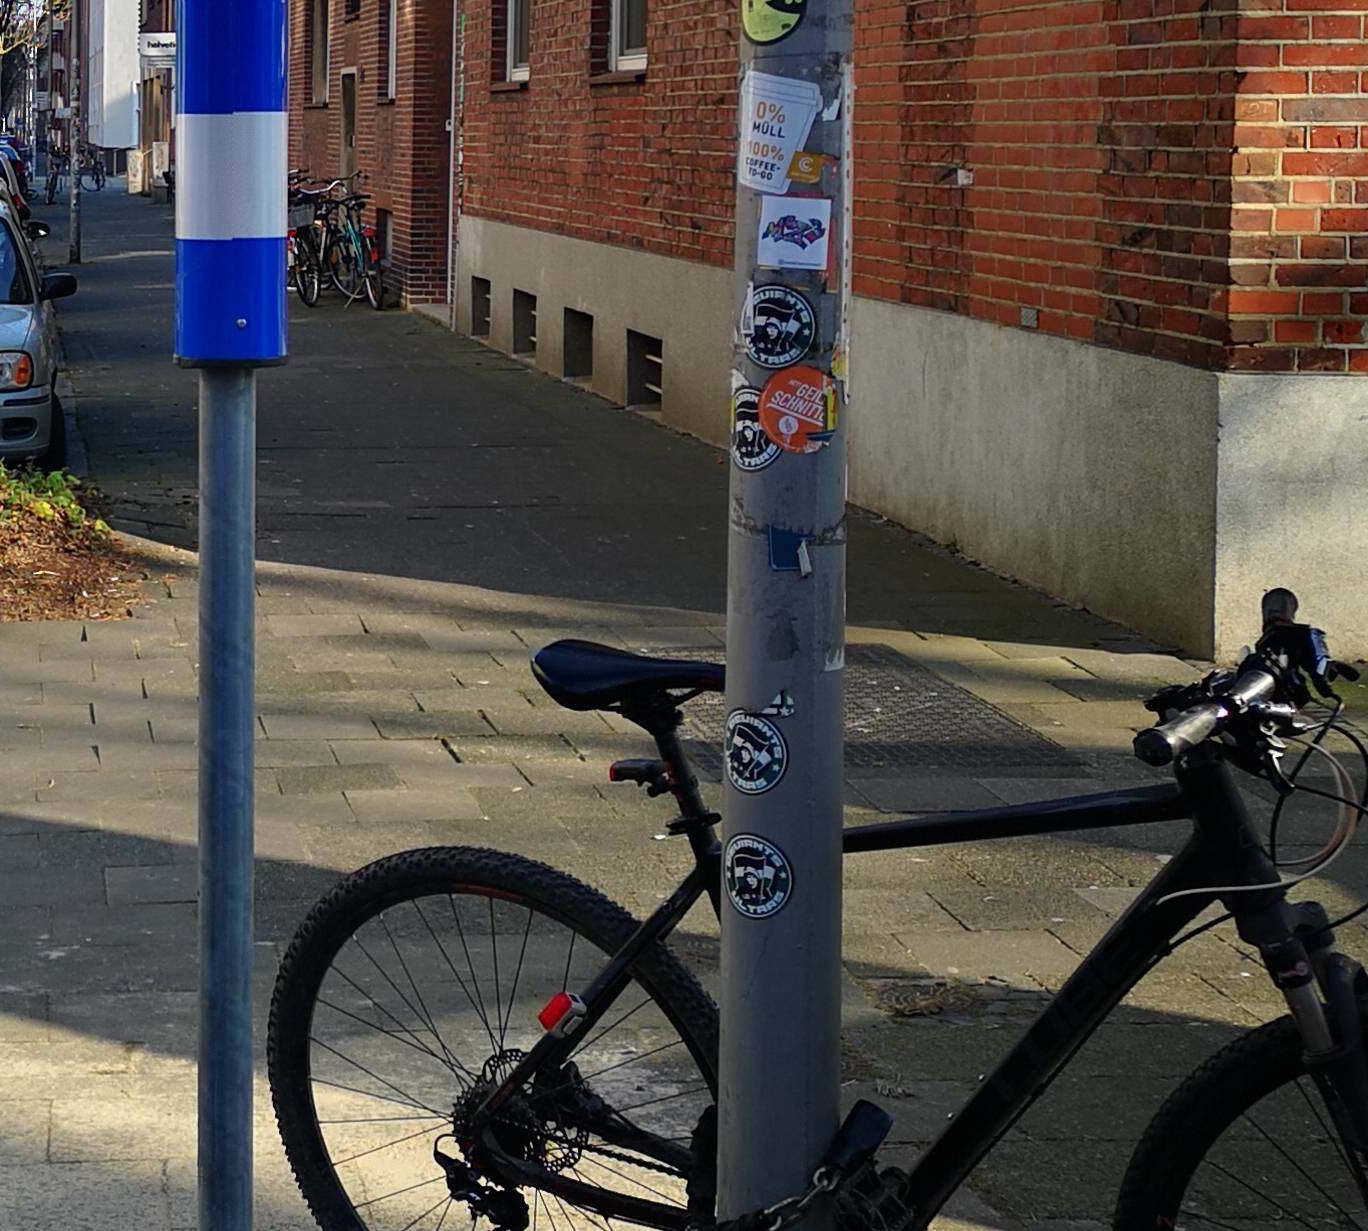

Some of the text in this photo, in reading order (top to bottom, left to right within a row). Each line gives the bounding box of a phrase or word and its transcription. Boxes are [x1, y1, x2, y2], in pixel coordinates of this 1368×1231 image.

[756, 101, 786, 124] 0%
[752, 121, 785, 138] MÜLL
[749, 141, 784, 161] 100%
[796, 383, 824, 405] GEIL
